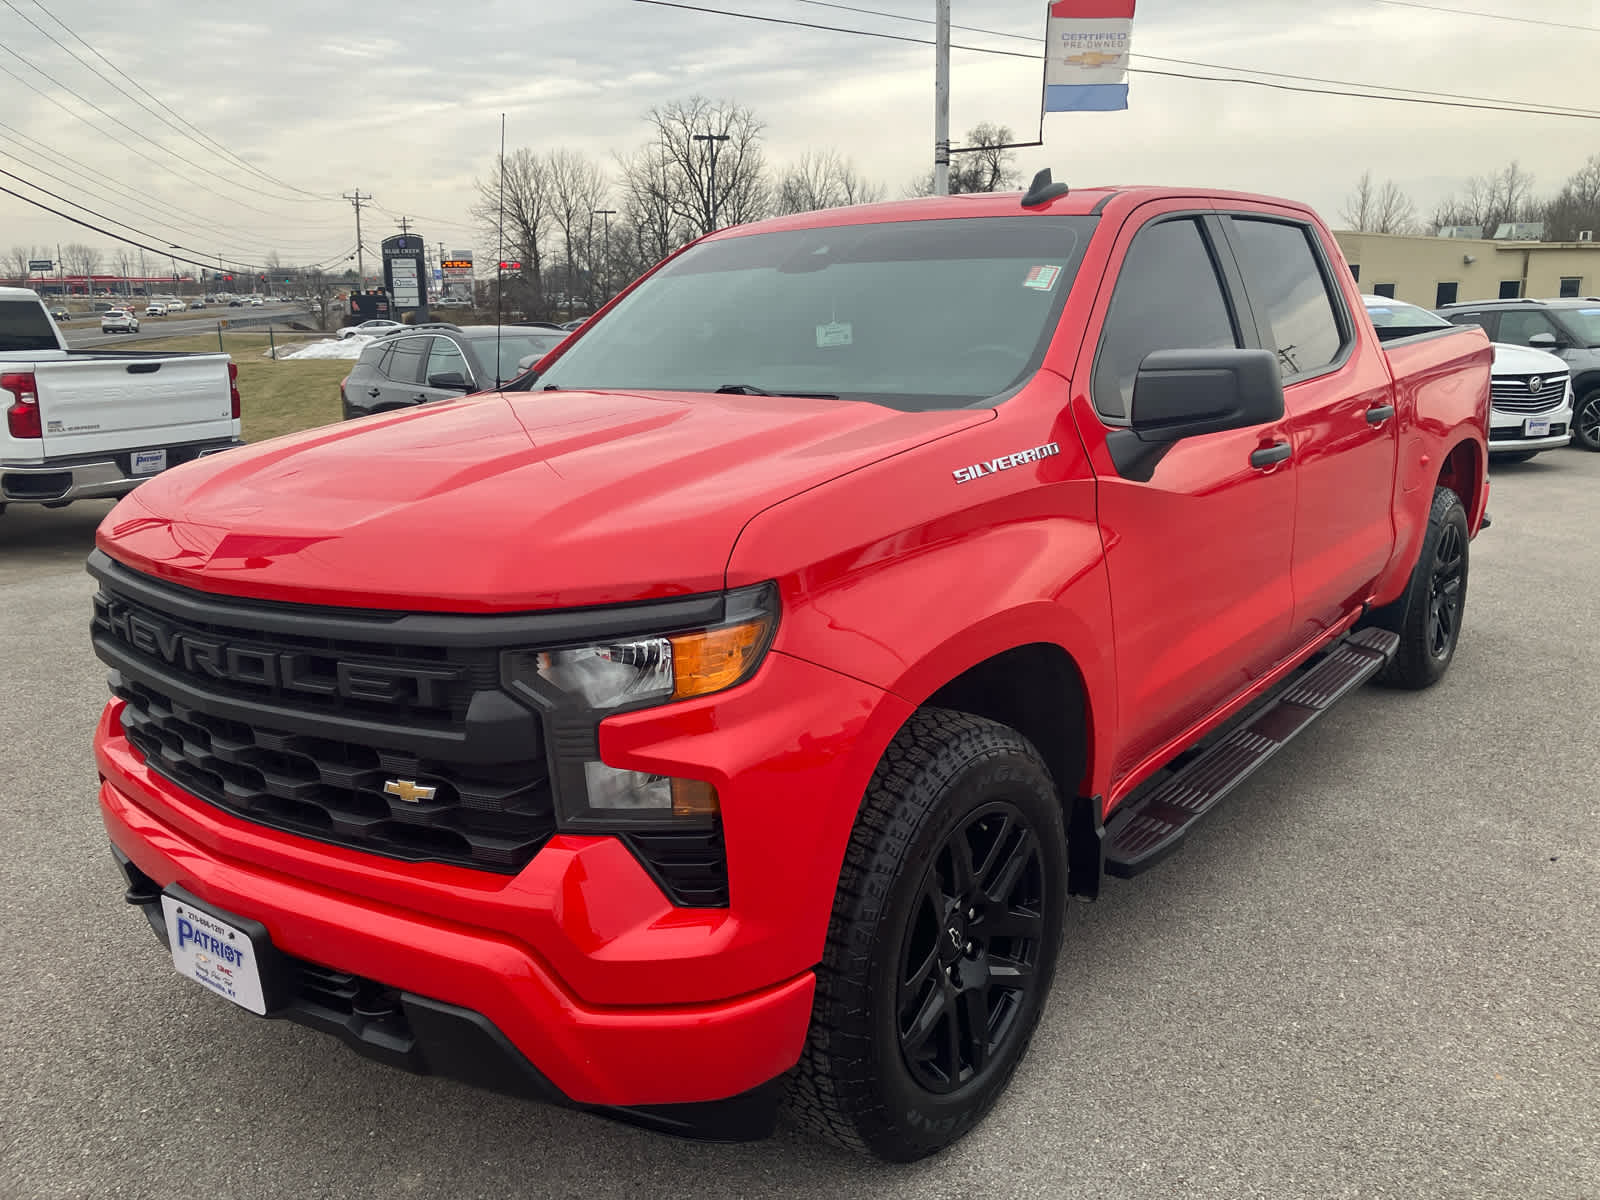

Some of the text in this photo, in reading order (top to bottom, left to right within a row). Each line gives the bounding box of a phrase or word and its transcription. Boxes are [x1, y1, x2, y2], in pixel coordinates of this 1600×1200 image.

[952, 442, 1060, 484] SILVERADO
[93, 592, 466, 706] CHEVROLET
[177, 917, 244, 968] PATRIOT
